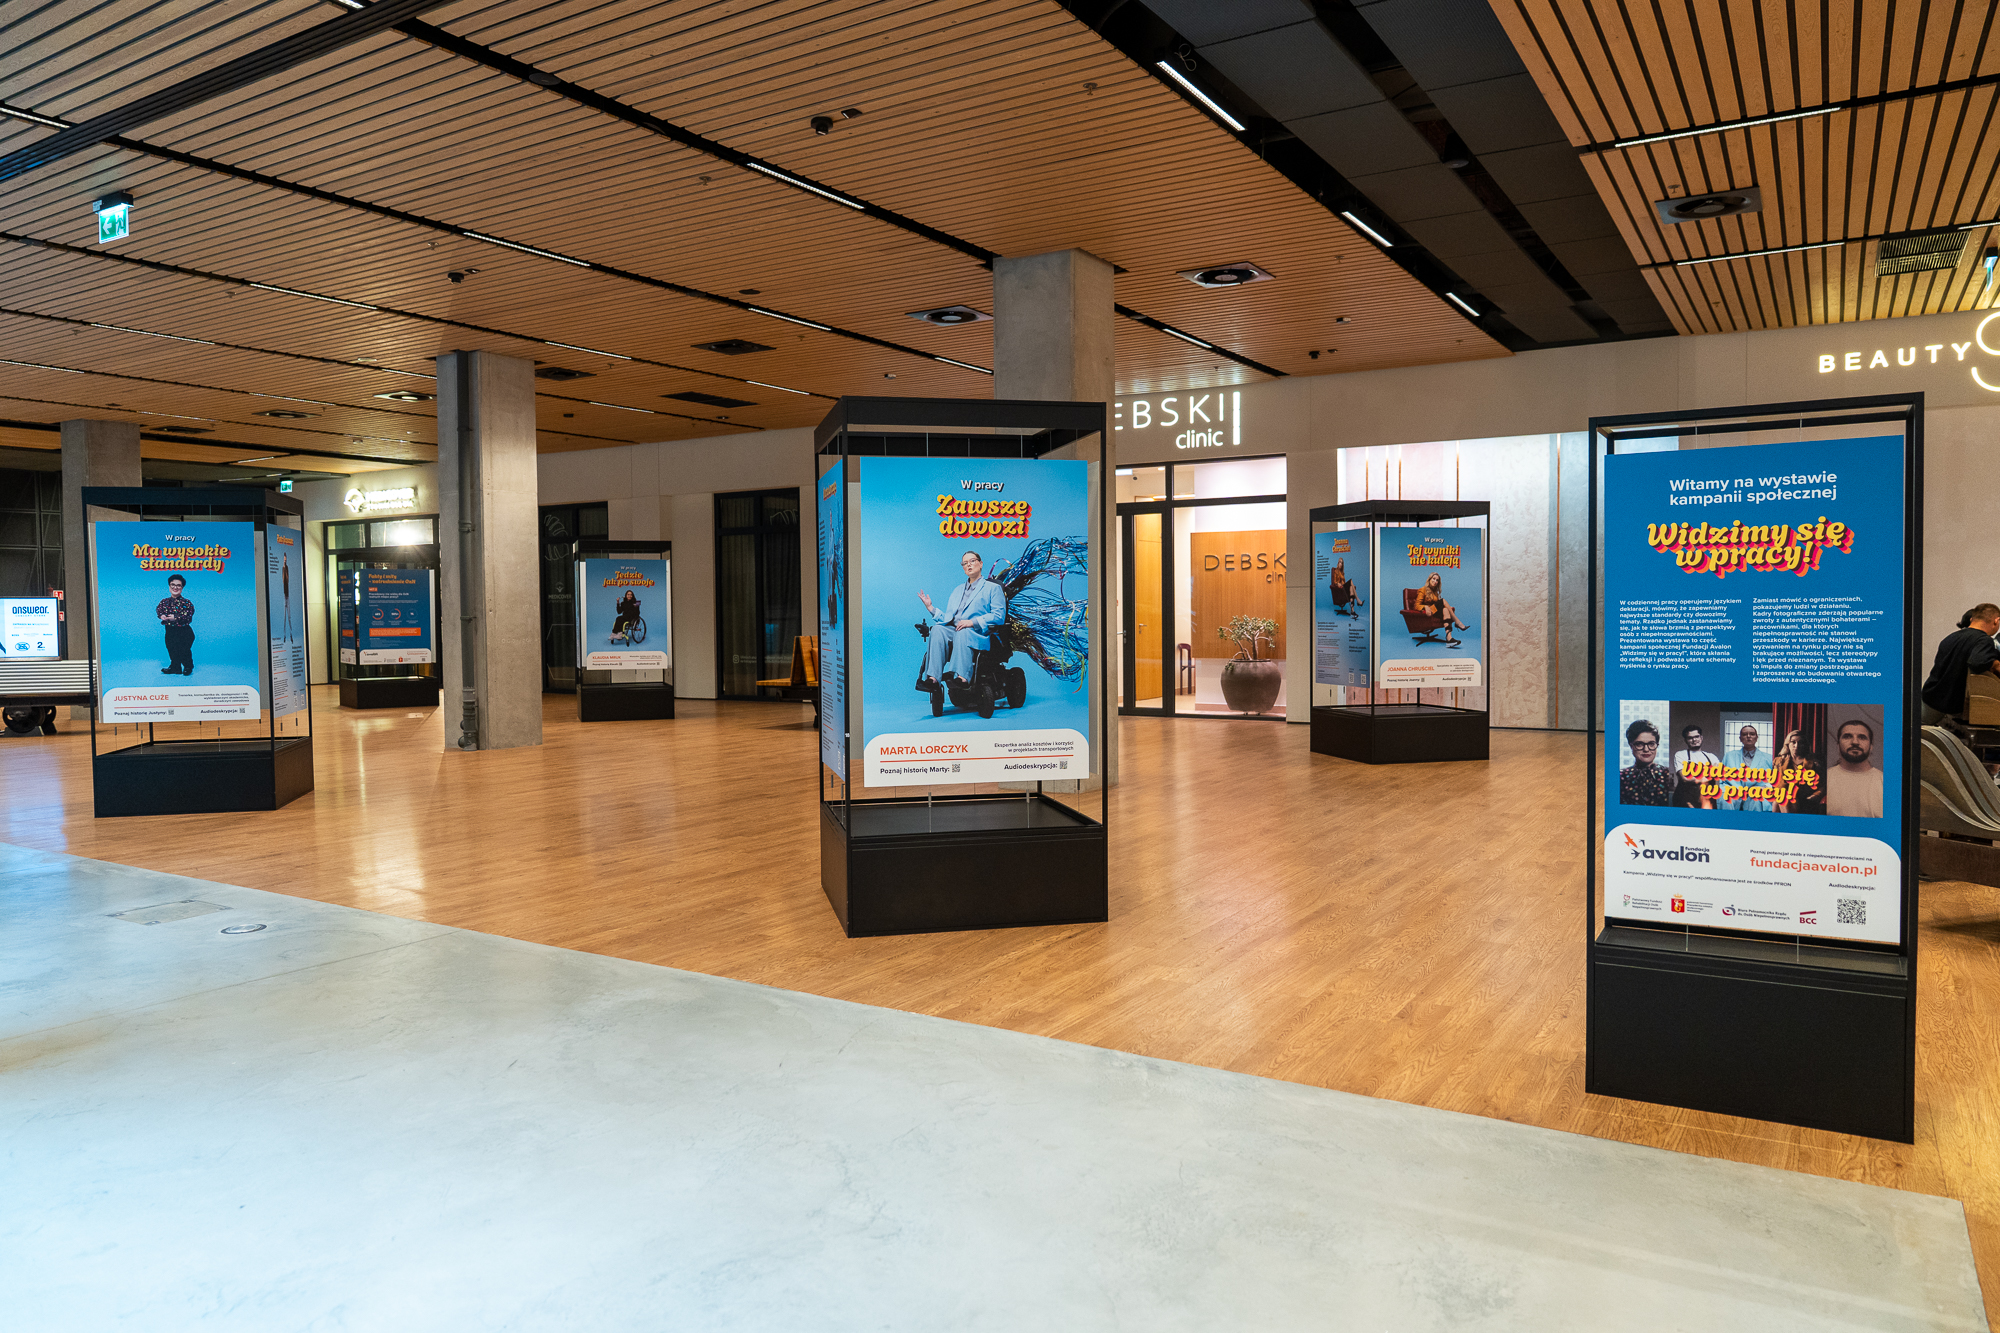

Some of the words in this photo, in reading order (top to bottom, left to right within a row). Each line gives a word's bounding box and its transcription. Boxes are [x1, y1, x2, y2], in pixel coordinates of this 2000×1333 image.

[1819, 341, 1971, 373] BEAUTY
[1115, 393, 1224, 431] BSKI
[1176, 428, 1223, 449] clinic
[961, 480, 972, 489] W
[975, 482, 1004, 492] pracy
[1670, 479, 1729, 491] Witamy
[1734, 478, 1753, 487] na
[1759, 471, 1837, 488] wystawie
[1670, 491, 1742, 506] kampanii
[1747, 486, 1837, 504] społecznej
[936, 494, 1032, 518] Zawsze
[939, 515, 1030, 539] dowozi
[1647, 520, 1796, 552] Widzimy
[1797, 516, 1854, 554] się
[132, 544, 162, 558] Ma
[163, 544, 231, 559] wysokie
[1407, 544, 1424, 558] Jej
[1424, 545, 1461, 558] wyniki
[1676, 549, 1710, 573] w
[1708, 541, 1822, 579] pracy!
[140, 557, 225, 574] standardy
[1204, 553, 1287, 571] DEBSK
[1410, 557, 1427, 566] nie
[1428, 555, 1460, 569] kuleją
[602, 578, 617, 588] jak
[618, 580, 629, 588] po
[630, 578, 655, 588] swoje
[615, 571, 643, 579] Jedzie
[1266, 571, 1287, 583] clini
[880, 746, 917, 755] MARTA
[920, 745, 968, 754] LORCZYK
[1682, 761, 1780, 785] Widzimy
[1783, 765, 1819, 789] się
[1700, 784, 1722, 799] w
[1723, 782, 1799, 806] pracy!
[1643, 846, 1710, 863] avalon
[1750, 857, 1877, 877] fundacjaavalon.pl
[1829, 883, 1875, 891] Audiodeskrypcja:
